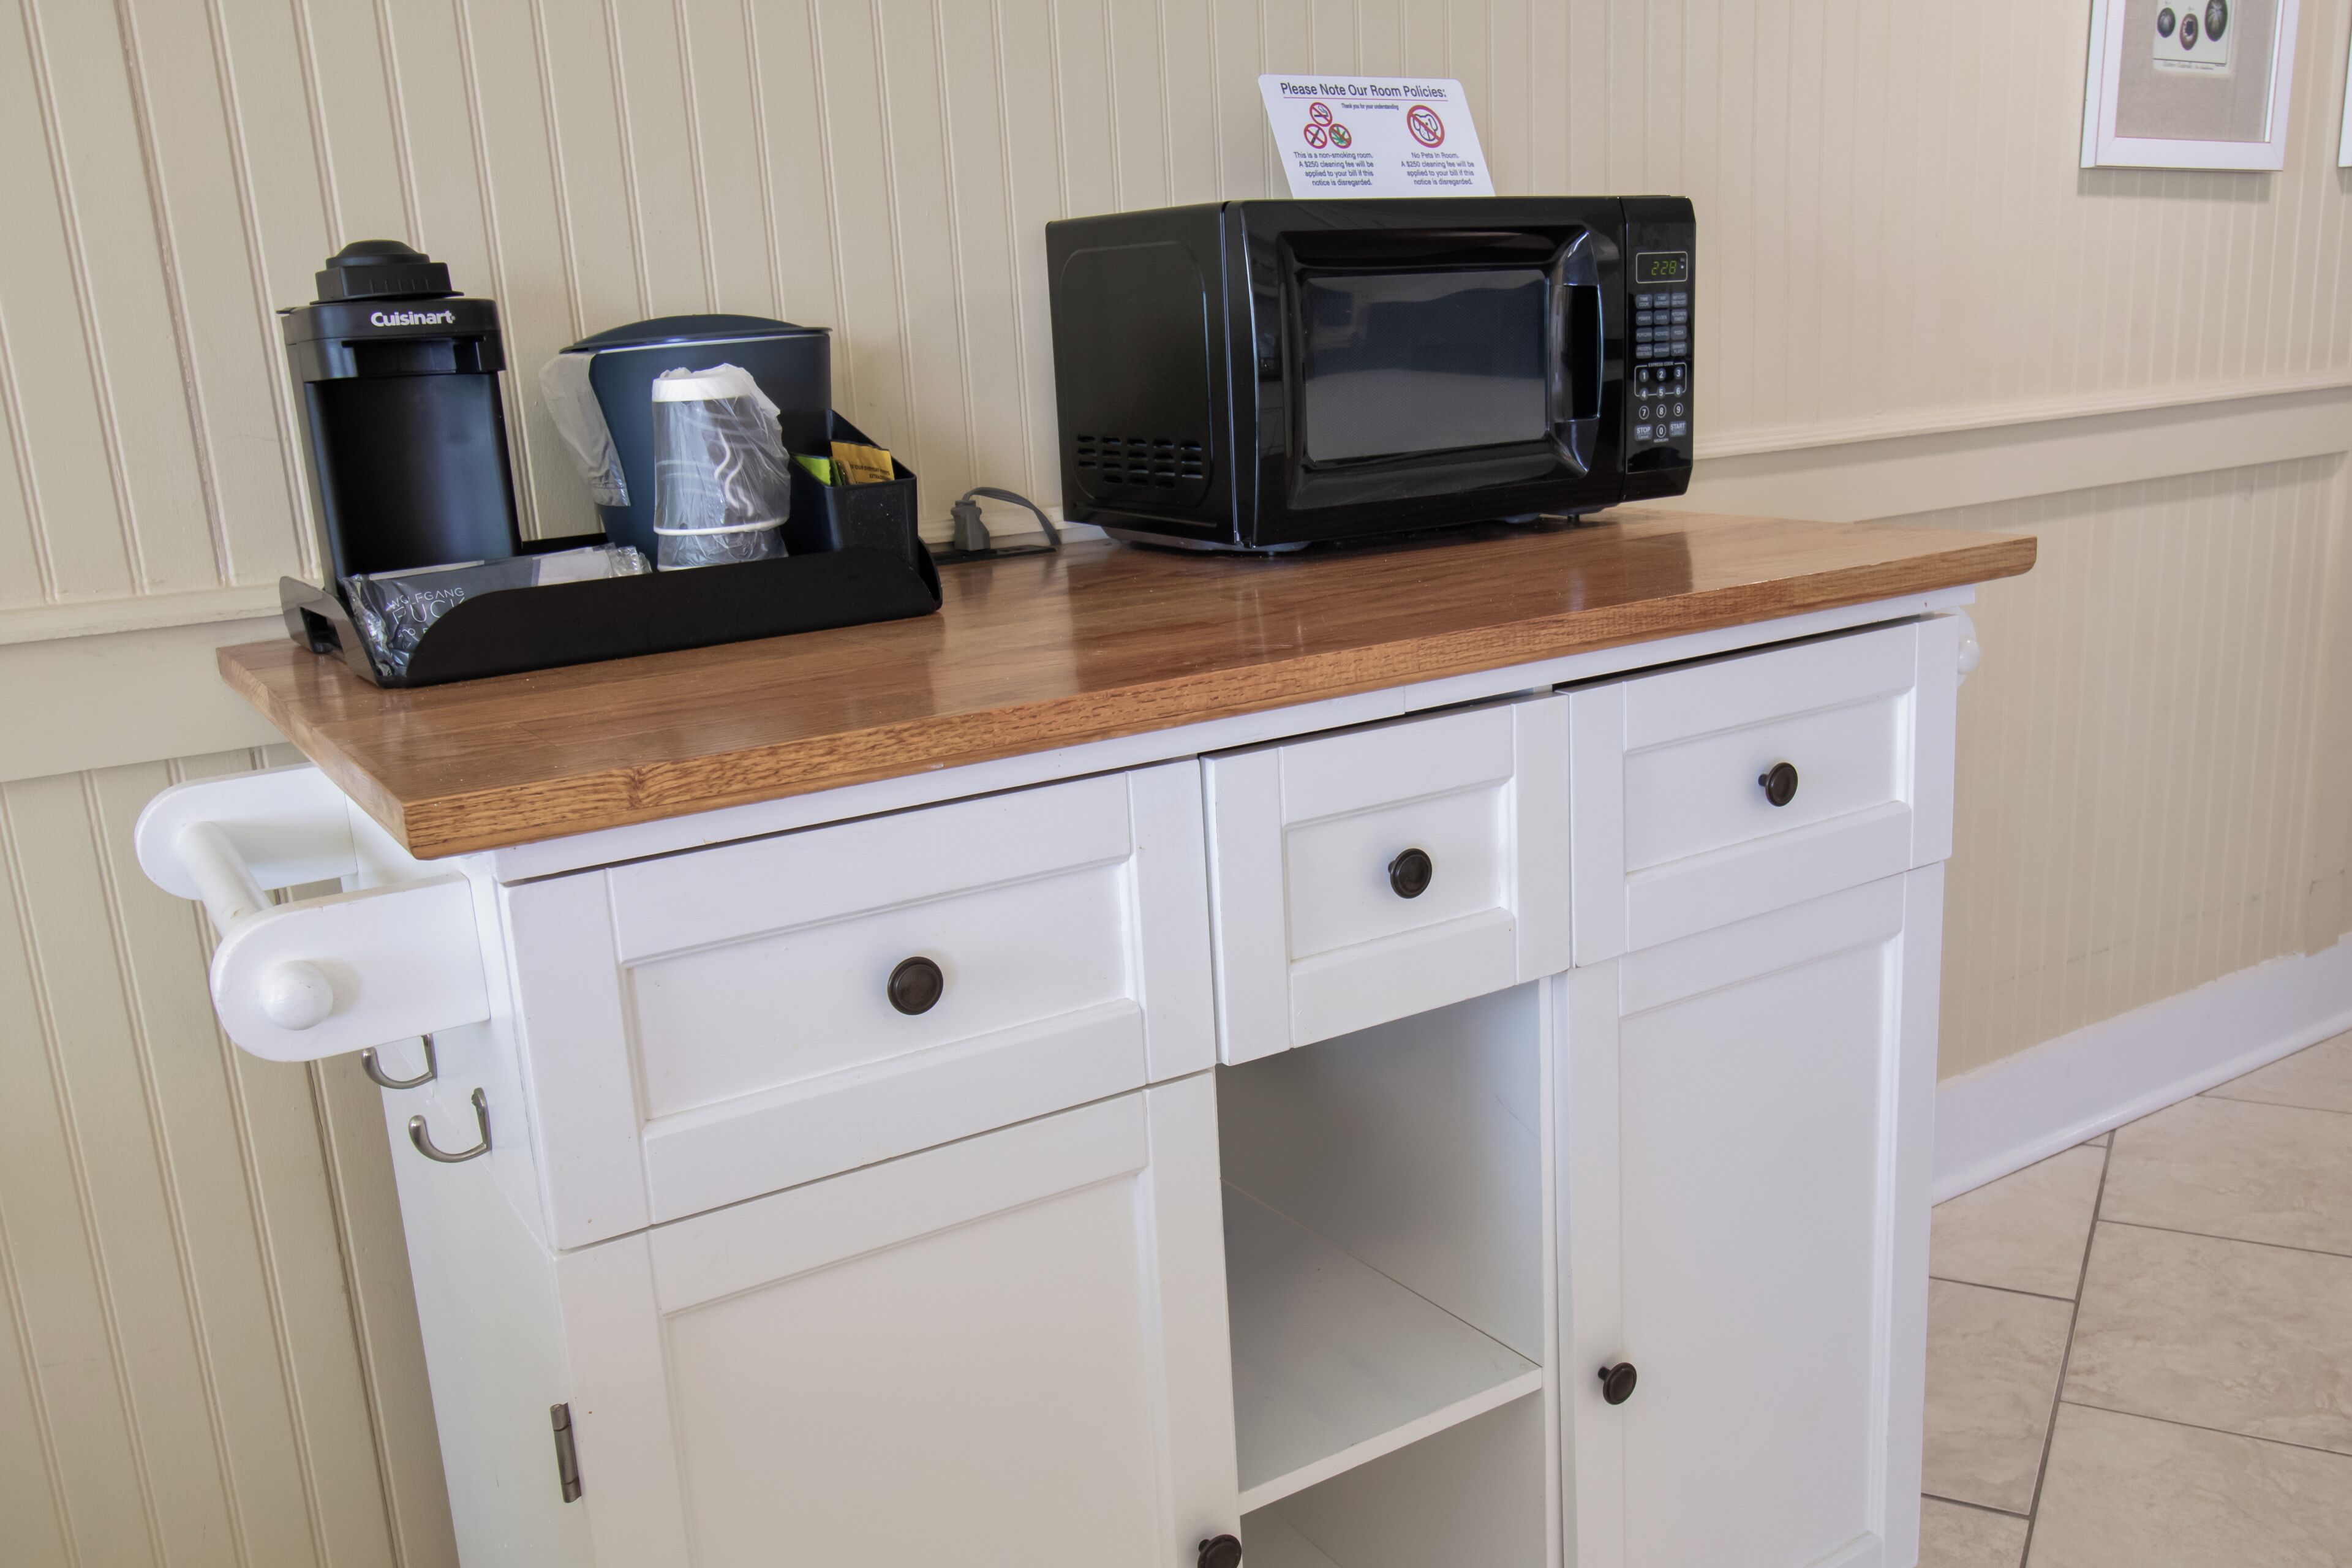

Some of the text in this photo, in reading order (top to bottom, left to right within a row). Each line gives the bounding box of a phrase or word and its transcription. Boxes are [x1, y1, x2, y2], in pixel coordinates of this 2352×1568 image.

[1280, 82, 1447, 98] Please Note Our Room Policies:
[371, 310, 453, 327] Cuisinart
[386, 587, 464, 611] WOLFGANG
